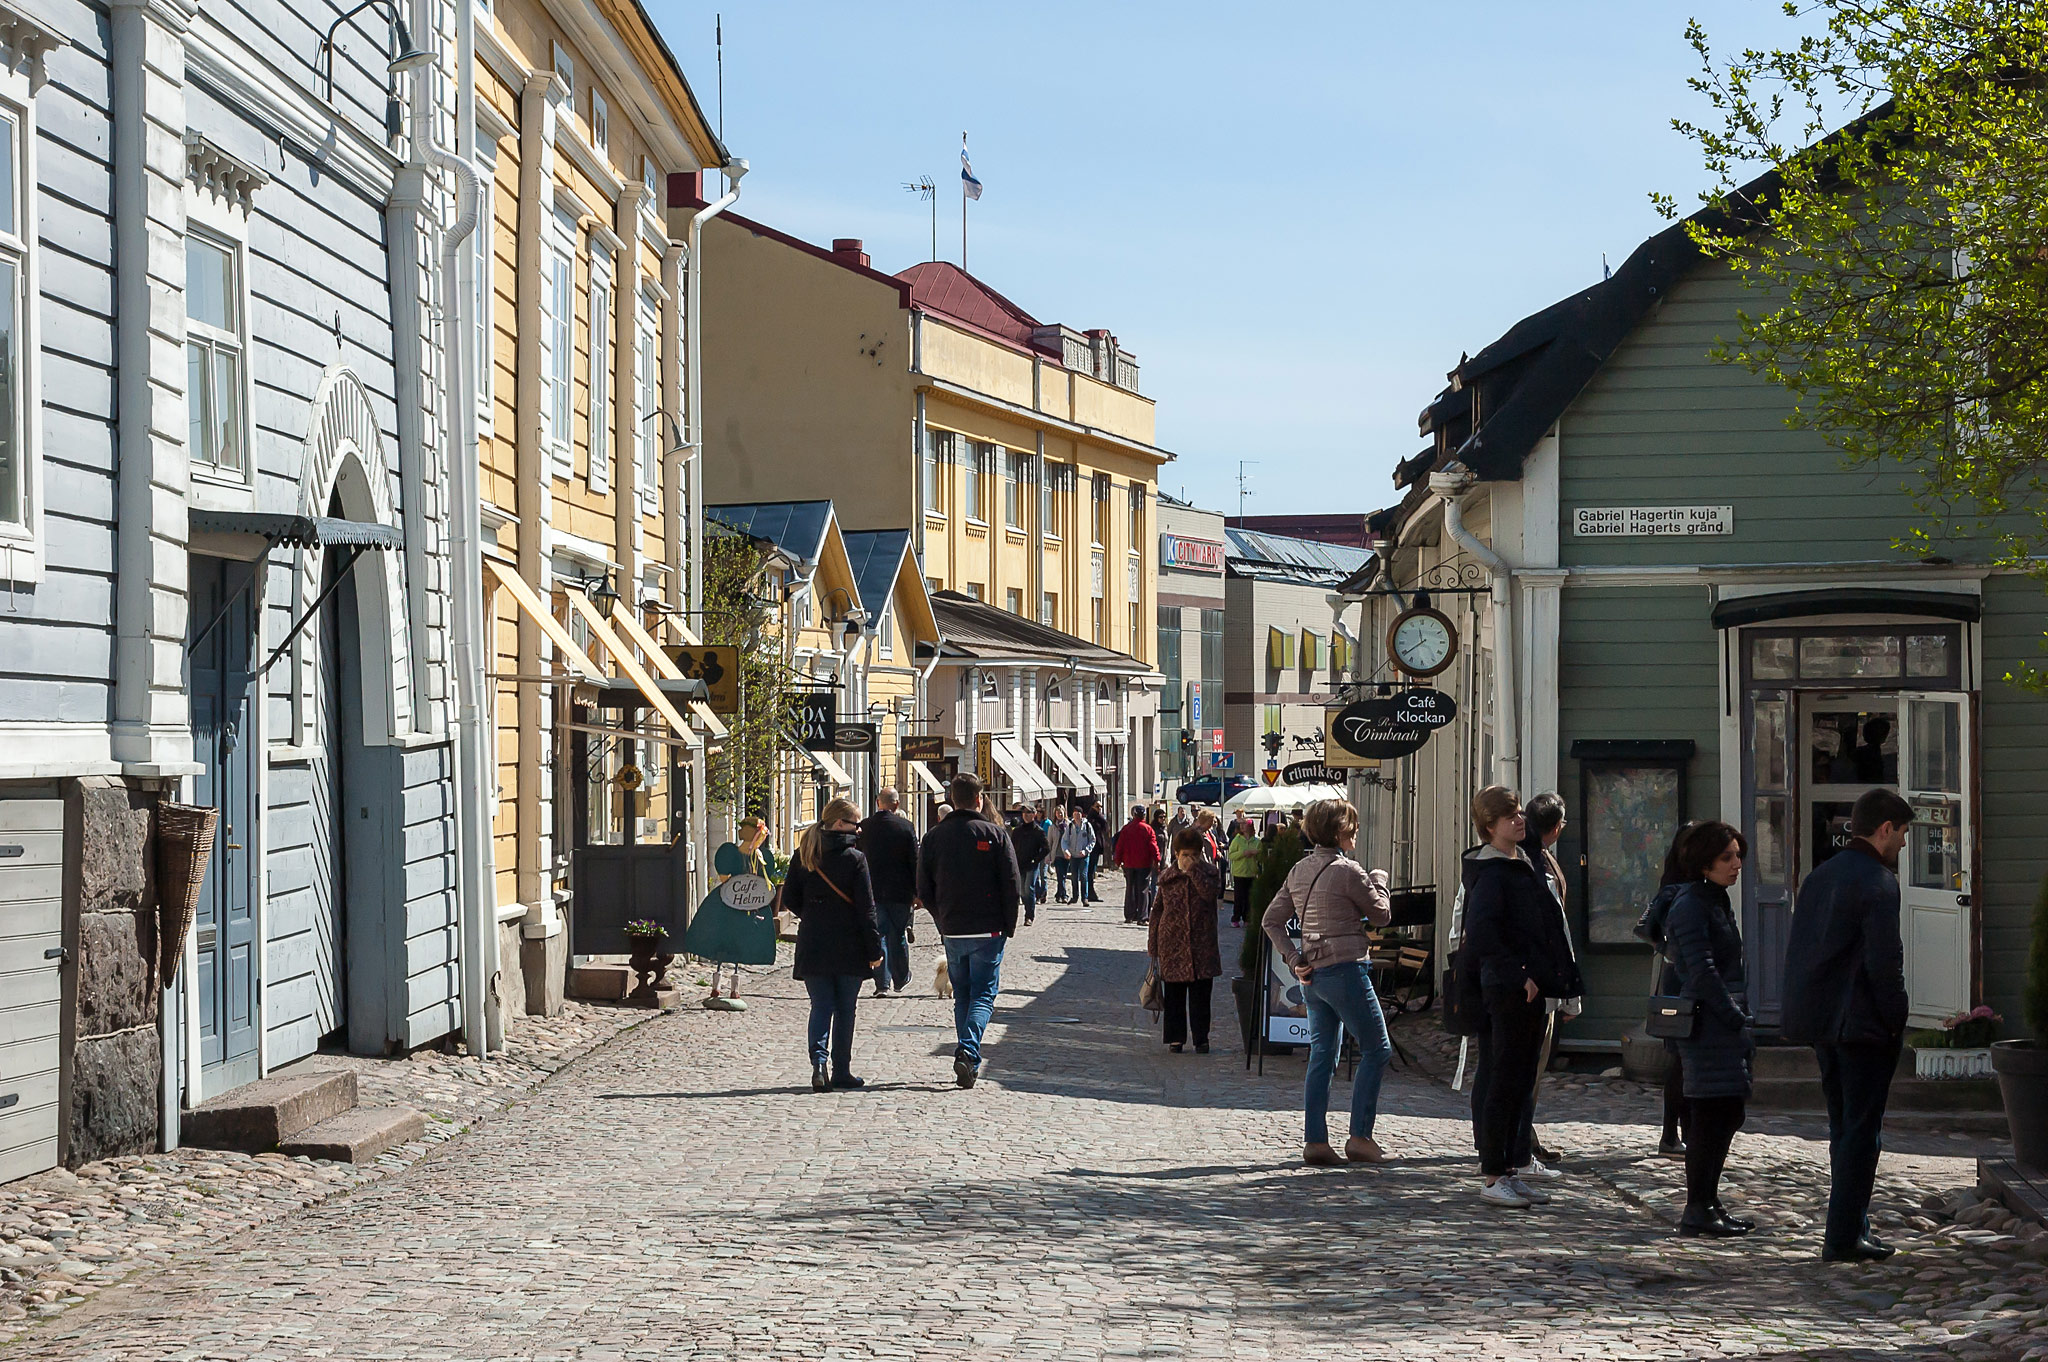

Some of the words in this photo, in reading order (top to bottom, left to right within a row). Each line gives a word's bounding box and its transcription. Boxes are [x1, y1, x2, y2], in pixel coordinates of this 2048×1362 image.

[1578, 510, 1625, 521] Gabriel
[1629, 509, 1684, 523] Hagertin
[1690, 509, 1717, 522] kuja
[1578, 523, 1625, 534] Gabriel
[1629, 522, 1681, 535] Hagerts
[1687, 521, 1724, 535] gränd
[1167, 537, 1175, 561] K
[1407, 695, 1436, 709] Café
[787, 706, 826, 723] NOA
[1396, 711, 1446, 723] Klockan
[732, 880, 758, 894] Café
[732, 892, 766, 905] Helmi
